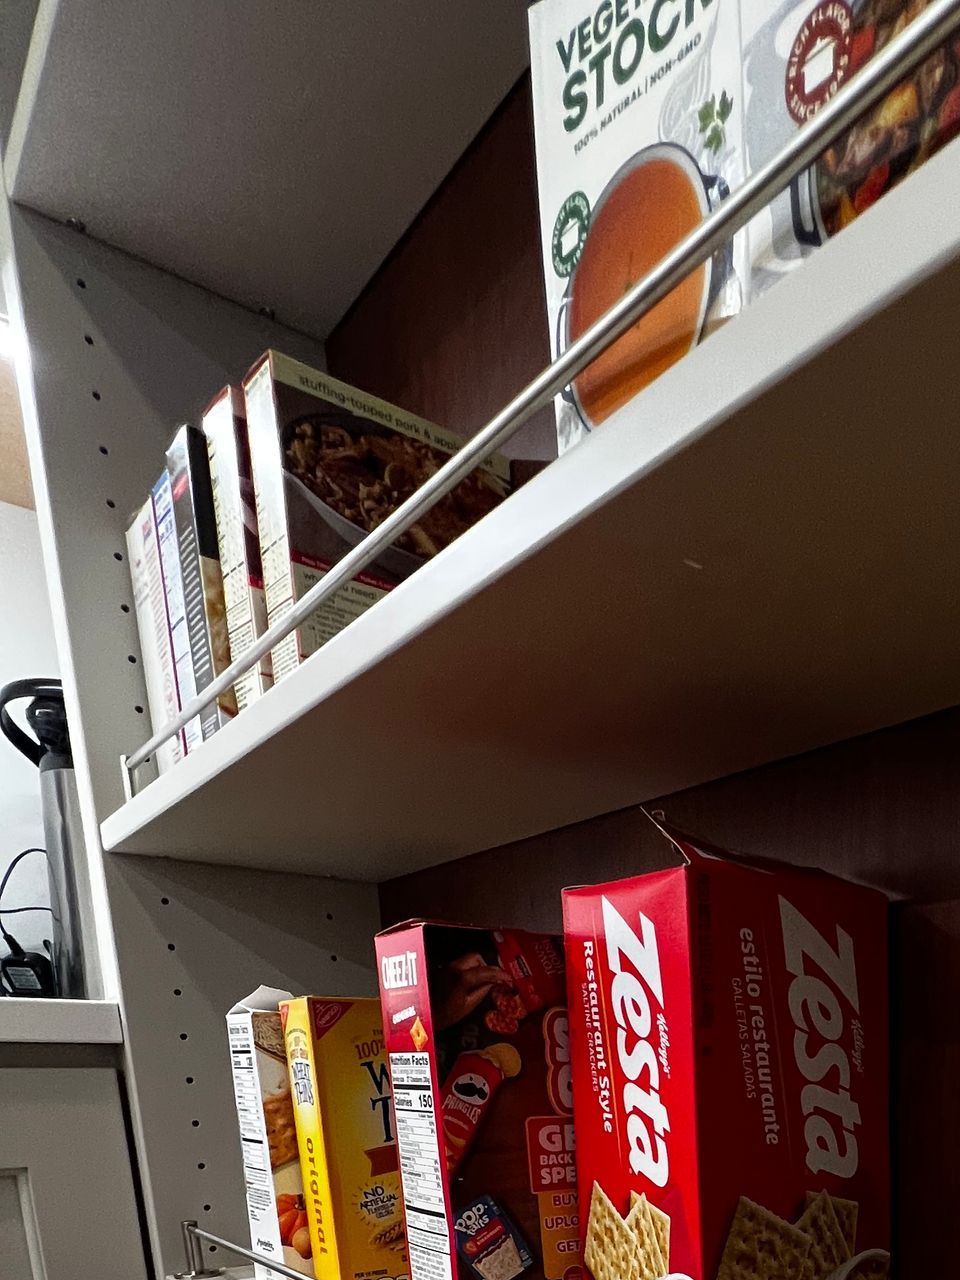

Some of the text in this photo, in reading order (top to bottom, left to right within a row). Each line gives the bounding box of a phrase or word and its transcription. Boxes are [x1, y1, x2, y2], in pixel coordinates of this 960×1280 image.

[600, 86, 643, 130] NATURAL
[650, 32, 701, 88] NON-GMO
[299, 375, 392, 424] stuffing-topped
[395, 417, 420, 435] pork
[581, 982, 599, 1092] SALTINE CRACKERS
[583, 941, 614, 1134] Restaurant Style
[601, 895, 671, 1188] Zesta
[731, 976, 757, 1099] GALLETAS SALADAS
[739, 927, 779, 1145] estilo restaurante
[778, 894, 862, 1179] Zesta
[418, 1094, 433, 1108] 150
[442, 1094, 482, 1124] PRINGLES
[538, 1125, 576, 1152] GE
[540, 1155, 572, 1165] BACK
[363, 1185, 385, 1199] NO
[541, 1166, 576, 1185] SPE
[544, 1216, 578, 1229] UPLO
